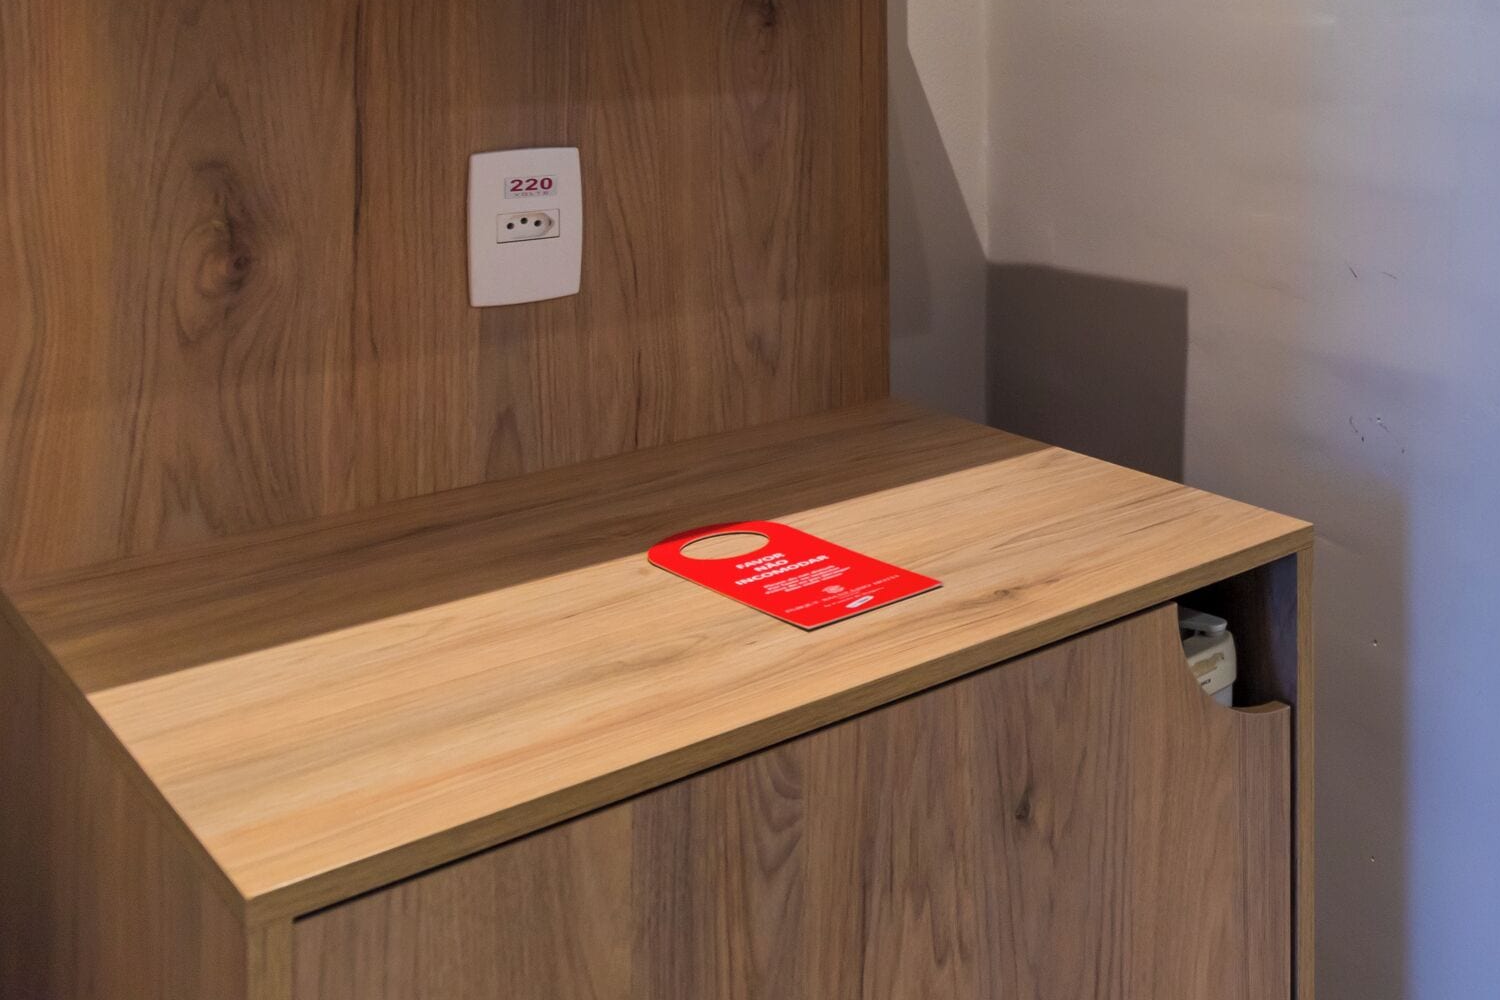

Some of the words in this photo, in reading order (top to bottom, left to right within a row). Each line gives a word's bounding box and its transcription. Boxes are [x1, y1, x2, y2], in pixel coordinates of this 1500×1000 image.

[510, 177, 553, 192] 220
[735, 555, 830, 585] INCOMODAR
[753, 559, 788, 572] NÃO
